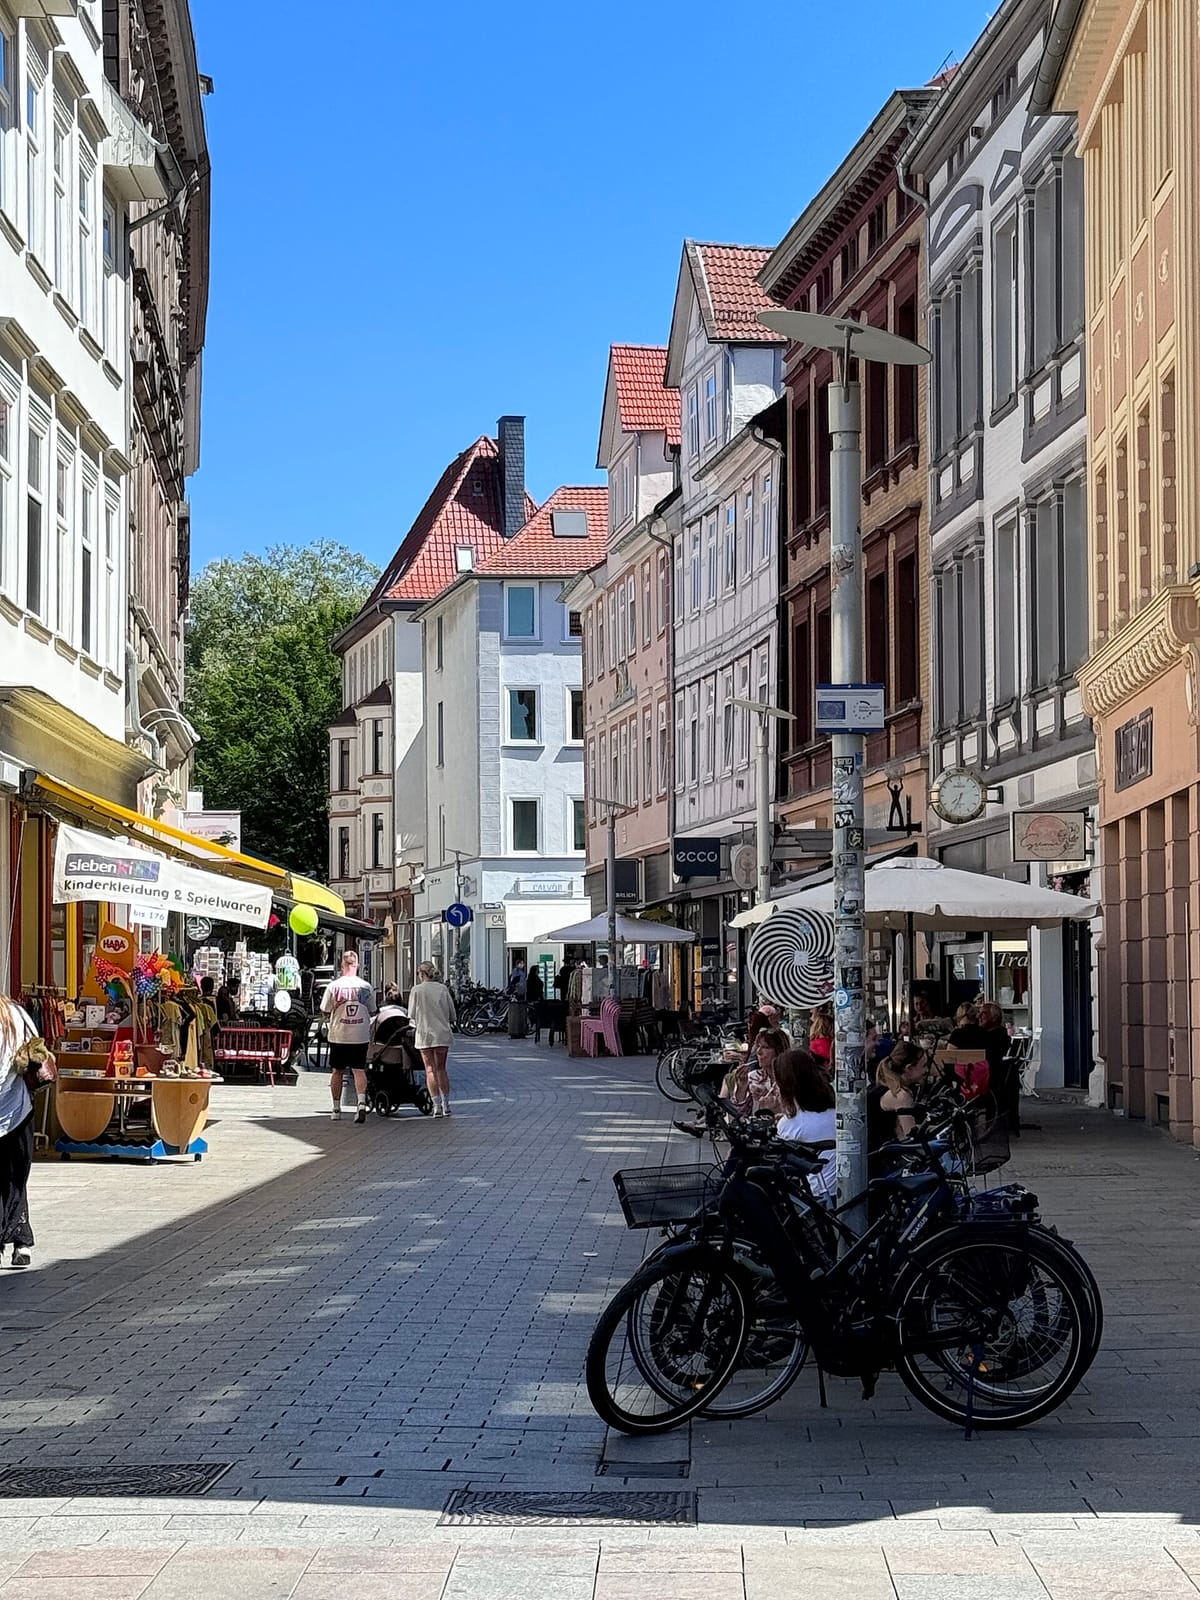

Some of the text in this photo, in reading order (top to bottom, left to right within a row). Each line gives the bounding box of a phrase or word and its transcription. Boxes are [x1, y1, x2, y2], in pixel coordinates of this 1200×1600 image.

[676, 851, 718, 863] ecco
[64, 880, 261, 915] Kinderkleidung & Spielwaren
[134, 910, 165, 921] bis 176
[103, 939, 126, 952] HABA
